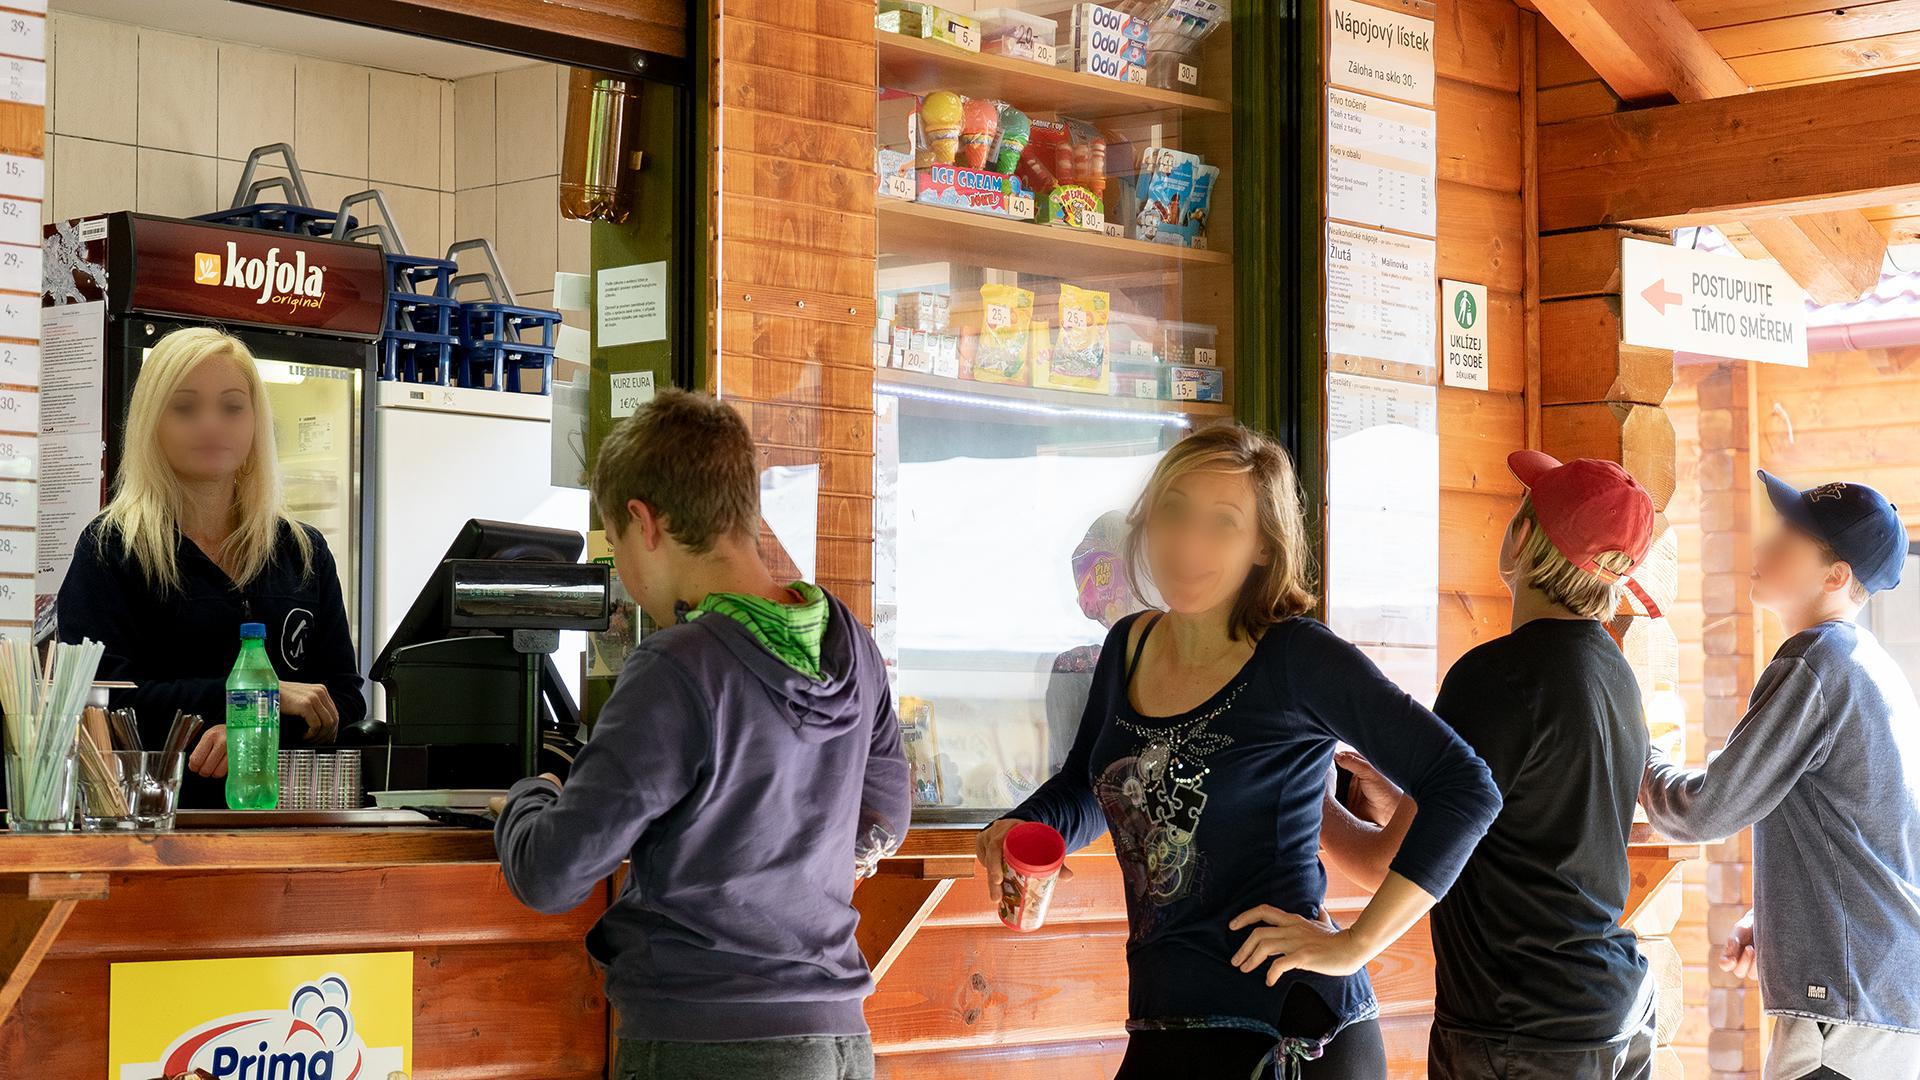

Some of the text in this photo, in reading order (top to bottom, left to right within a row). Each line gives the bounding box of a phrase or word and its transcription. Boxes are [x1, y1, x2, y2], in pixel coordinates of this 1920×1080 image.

[11, 19, 30, 36] 39,-
[1093, 7, 1122, 31] Odol
[962, 31, 973, 46] 5,-
[1335, 9, 1429, 52] Nápojový lístek
[1092, 31, 1120, 55] Odol
[1038, 46, 1052, 62] 20,-
[1091, 53, 1119, 77] Odol
[1181, 66, 1194, 81] 30,-
[1131, 69, 1144, 84] 30,-
[1348, 60, 1417, 88] Záloha na sklo 30,-
[1344, 97, 1367, 112] točené
[6, 161, 25, 178] 15,-
[894, 180, 911, 195] 40,-
[931, 166, 1003, 193] ICE CREAM
[3, 202, 23, 218] 52,-
[1013, 200, 1030, 216] 40,-
[1086, 214, 1101, 229] 30,-
[4, 252, 24, 269] 29,-
[1330, 243, 1352, 262] Žlutá
[1381, 257, 1409, 271] Malinovka
[224, 241, 323, 305] kofola
[1692, 272, 1773, 307] POSTUPUJTE
[271, 291, 326, 315] original
[5, 304, 19, 320] 4,-
[992, 308, 1007, 325] 25,-
[1067, 310, 1084, 328] 25,-
[1692, 306, 1793, 345] TÍMTO SMĚREM
[1450, 334, 1482, 352] UKLÍZEJ
[4, 351, 18, 365] 2,-
[908, 353, 925, 368] 20,-
[1199, 351, 1212, 365] 10,-
[1450, 352, 1483, 370] PO SOBĚ
[613, 376, 651, 389] KURZ EURA
[1142, 382, 1151, 396] 5,-
[1176, 384, 1192, 397] 15,-
[212, 1040, 334, 1080] Prima
